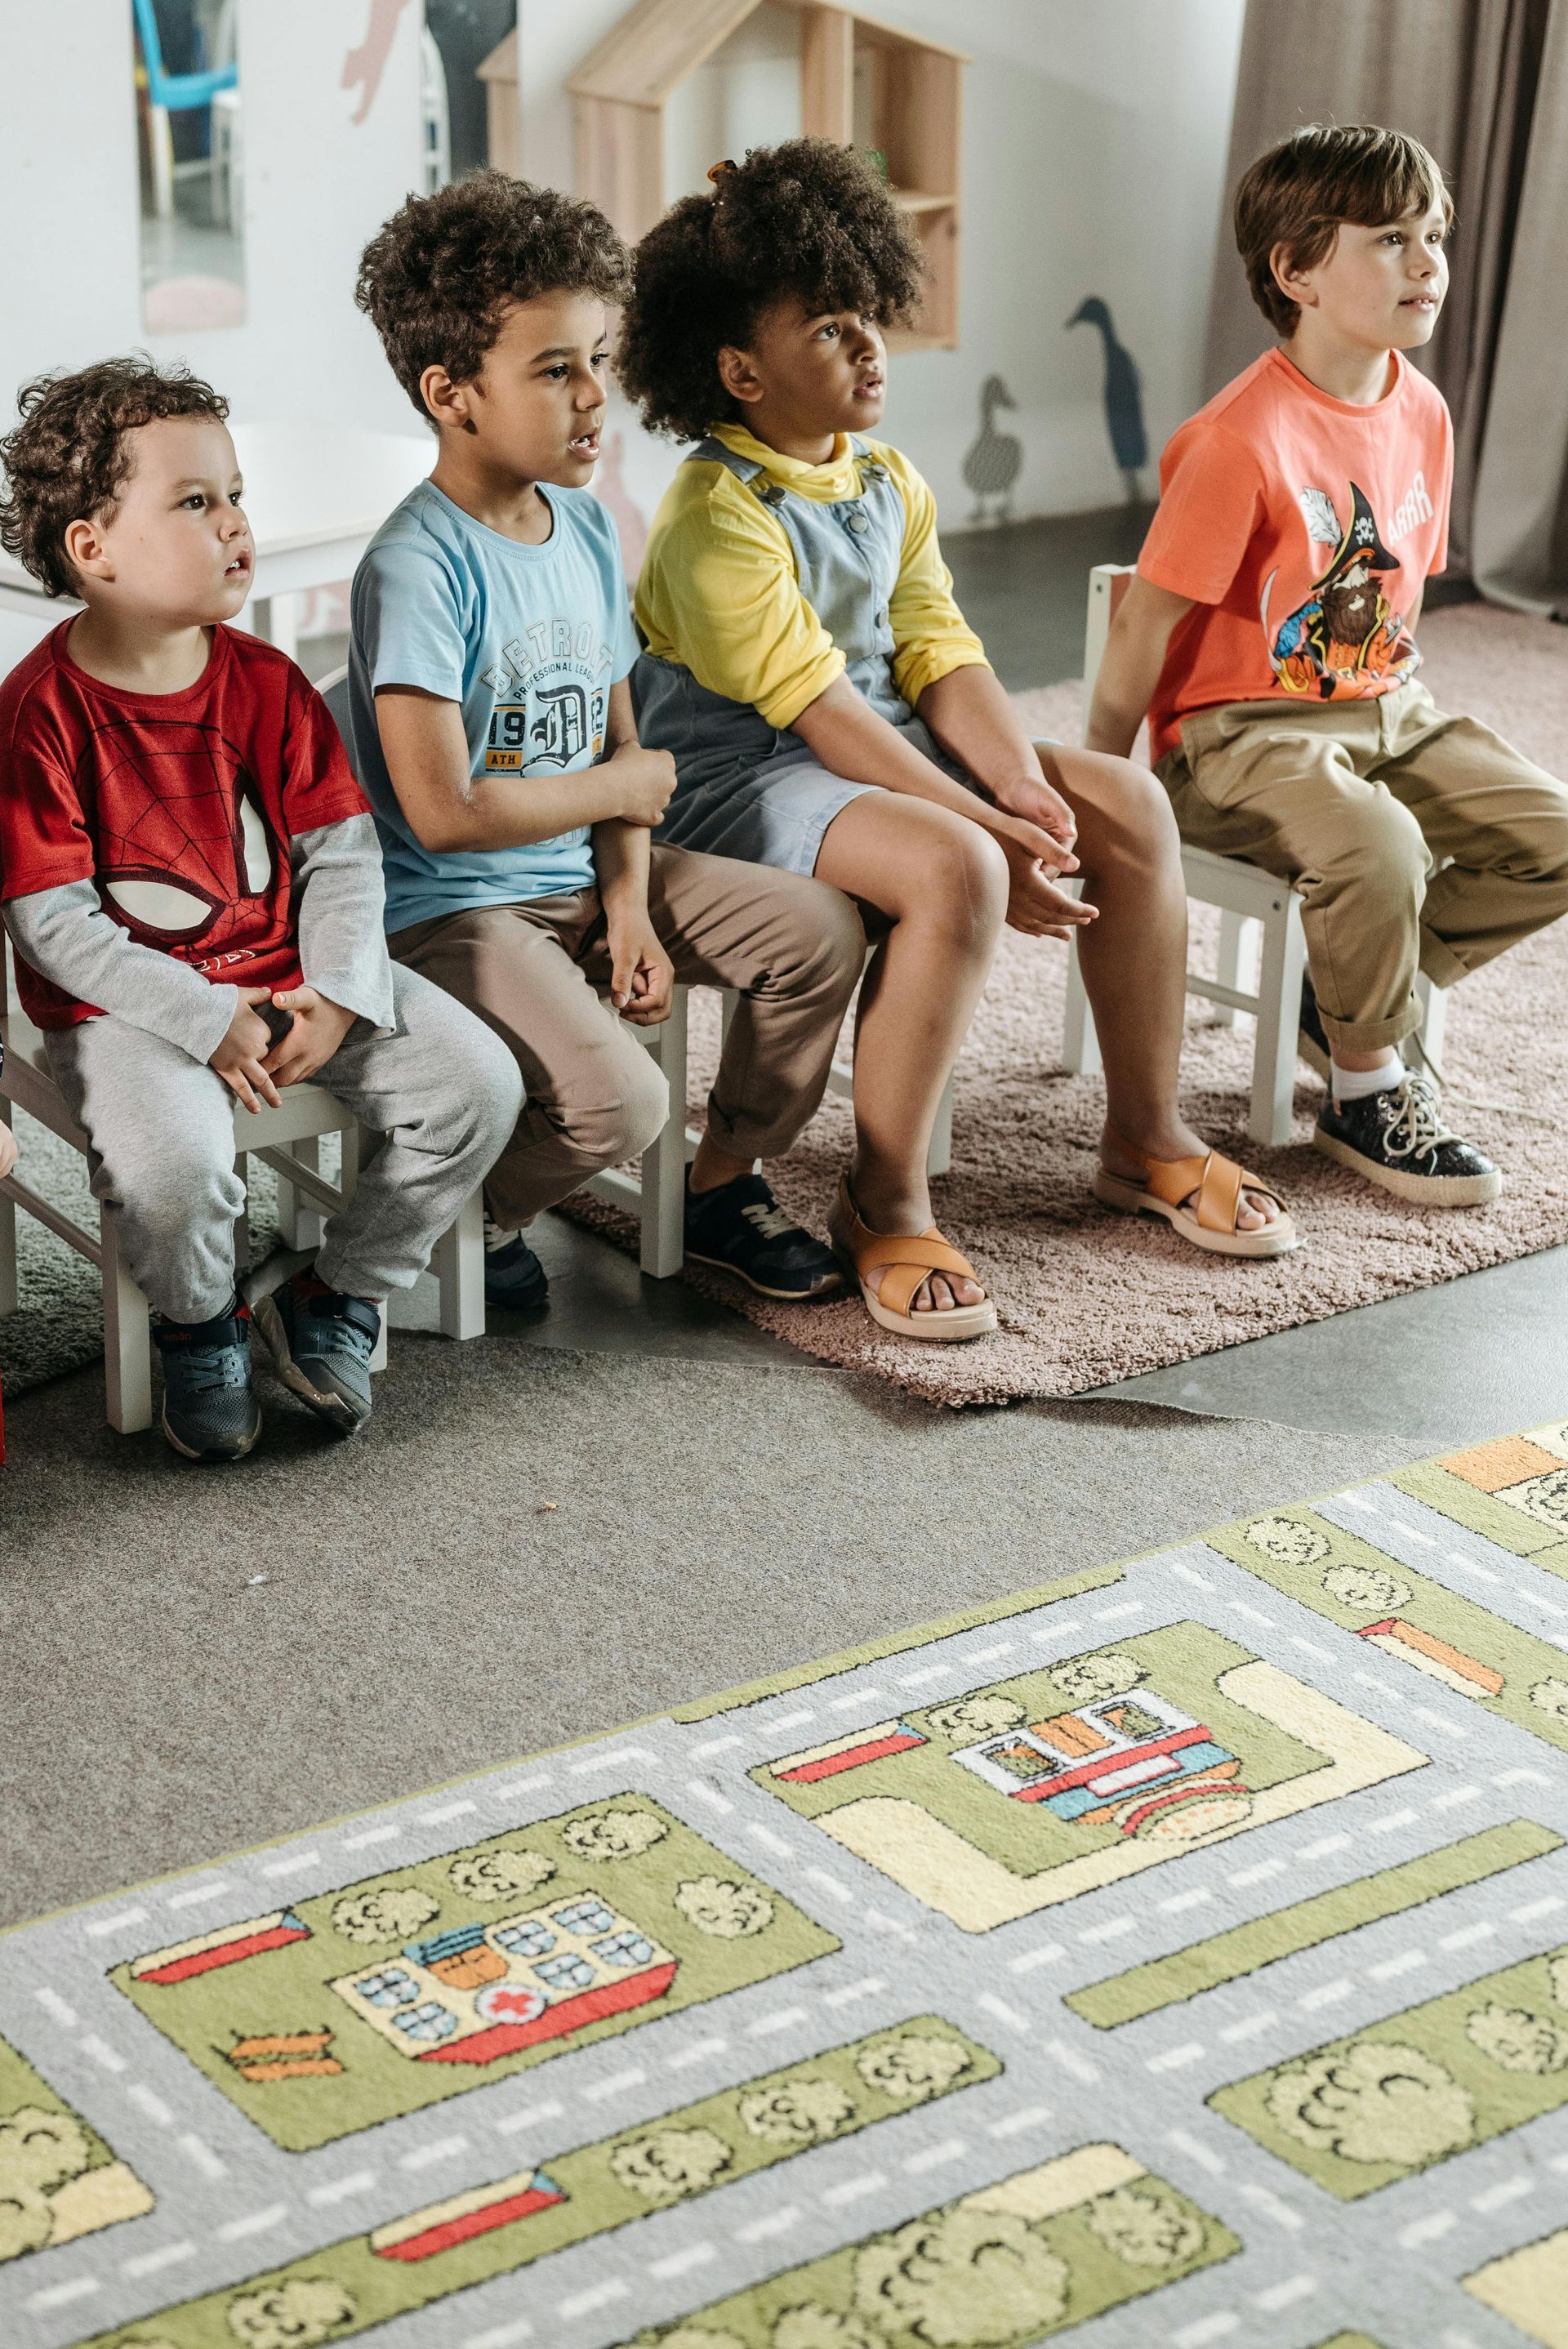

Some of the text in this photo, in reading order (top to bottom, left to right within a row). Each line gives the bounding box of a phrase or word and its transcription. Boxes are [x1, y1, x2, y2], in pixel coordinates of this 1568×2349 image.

[1388, 470, 1434, 546] ARRR
[479, 617, 613, 698] DETROIT
[513, 662, 572, 701] PROFESSIONAL
[488, 711, 526, 746] 19
[491, 754, 516, 764] ATH
